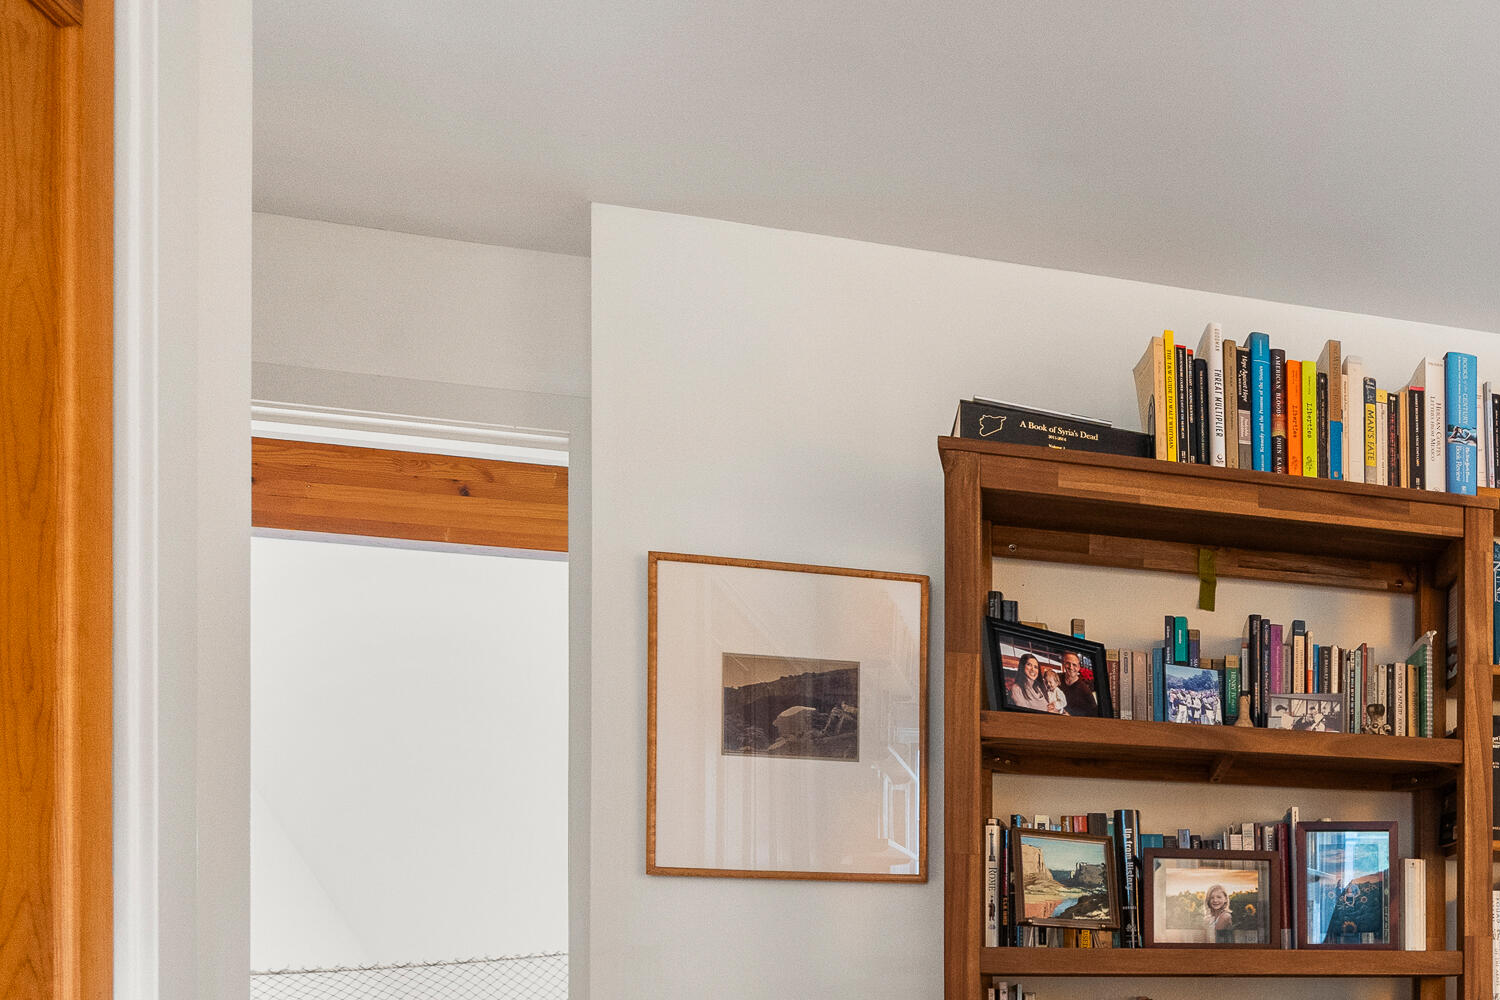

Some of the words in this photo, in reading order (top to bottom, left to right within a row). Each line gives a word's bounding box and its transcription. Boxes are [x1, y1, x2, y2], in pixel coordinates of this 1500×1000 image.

[1215, 369, 1223, 395] THREAT
[1215, 397, 1223, 437] MULTIPLIER
[1028, 421, 1046, 433] Book
[1057, 427, 1078, 439] Syria's
[1079, 431, 1098, 441] Dead
[1124, 828, 1133, 839] Up
[1125, 841, 1133, 859] from
[989, 867, 997, 890] ROME
[1125, 862, 1134, 890] History
[1082, 931, 1090, 948] USED
